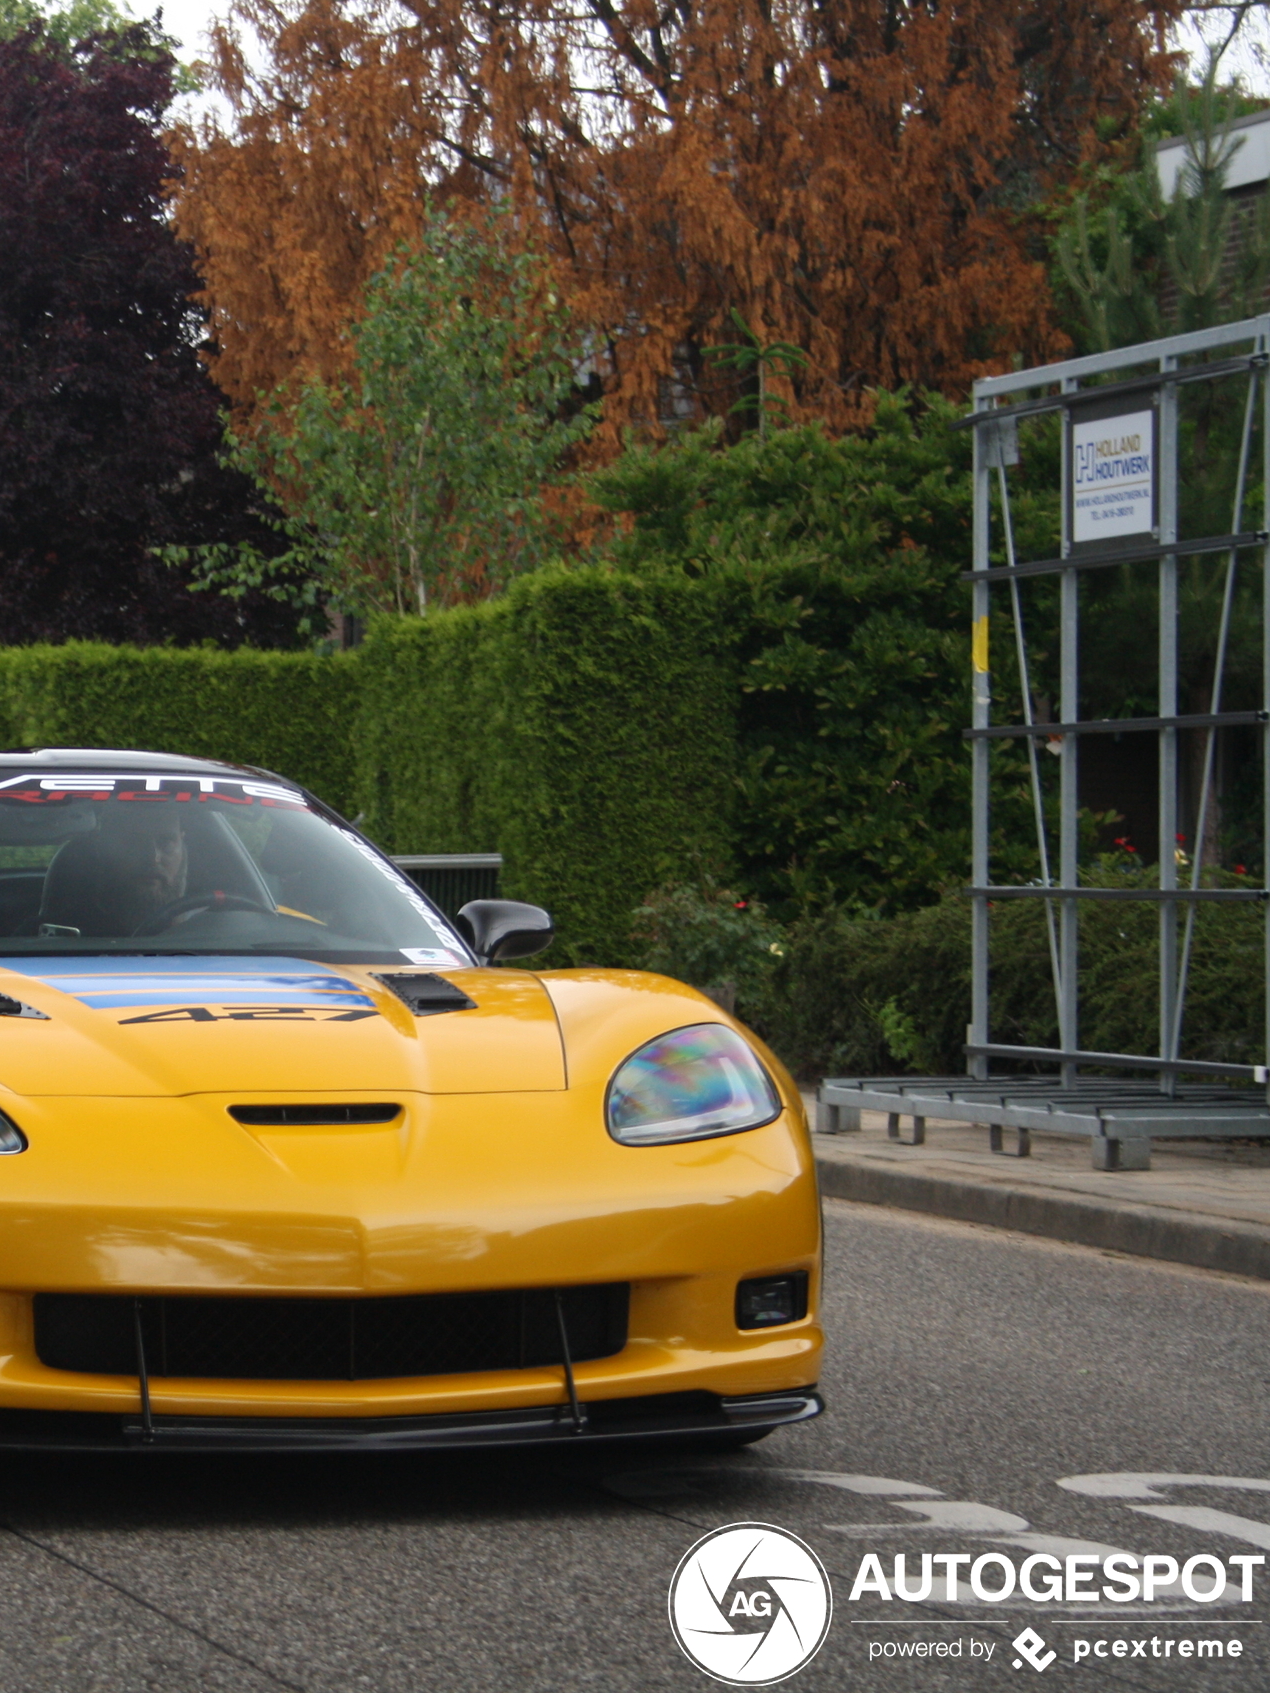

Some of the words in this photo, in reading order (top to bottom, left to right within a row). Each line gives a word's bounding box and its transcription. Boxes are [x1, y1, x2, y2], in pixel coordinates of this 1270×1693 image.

[1096, 434, 1141, 458] HOLLAND
[1096, 455, 1150, 480] HOUTWERK
[117, 1007, 381, 1025] 427
